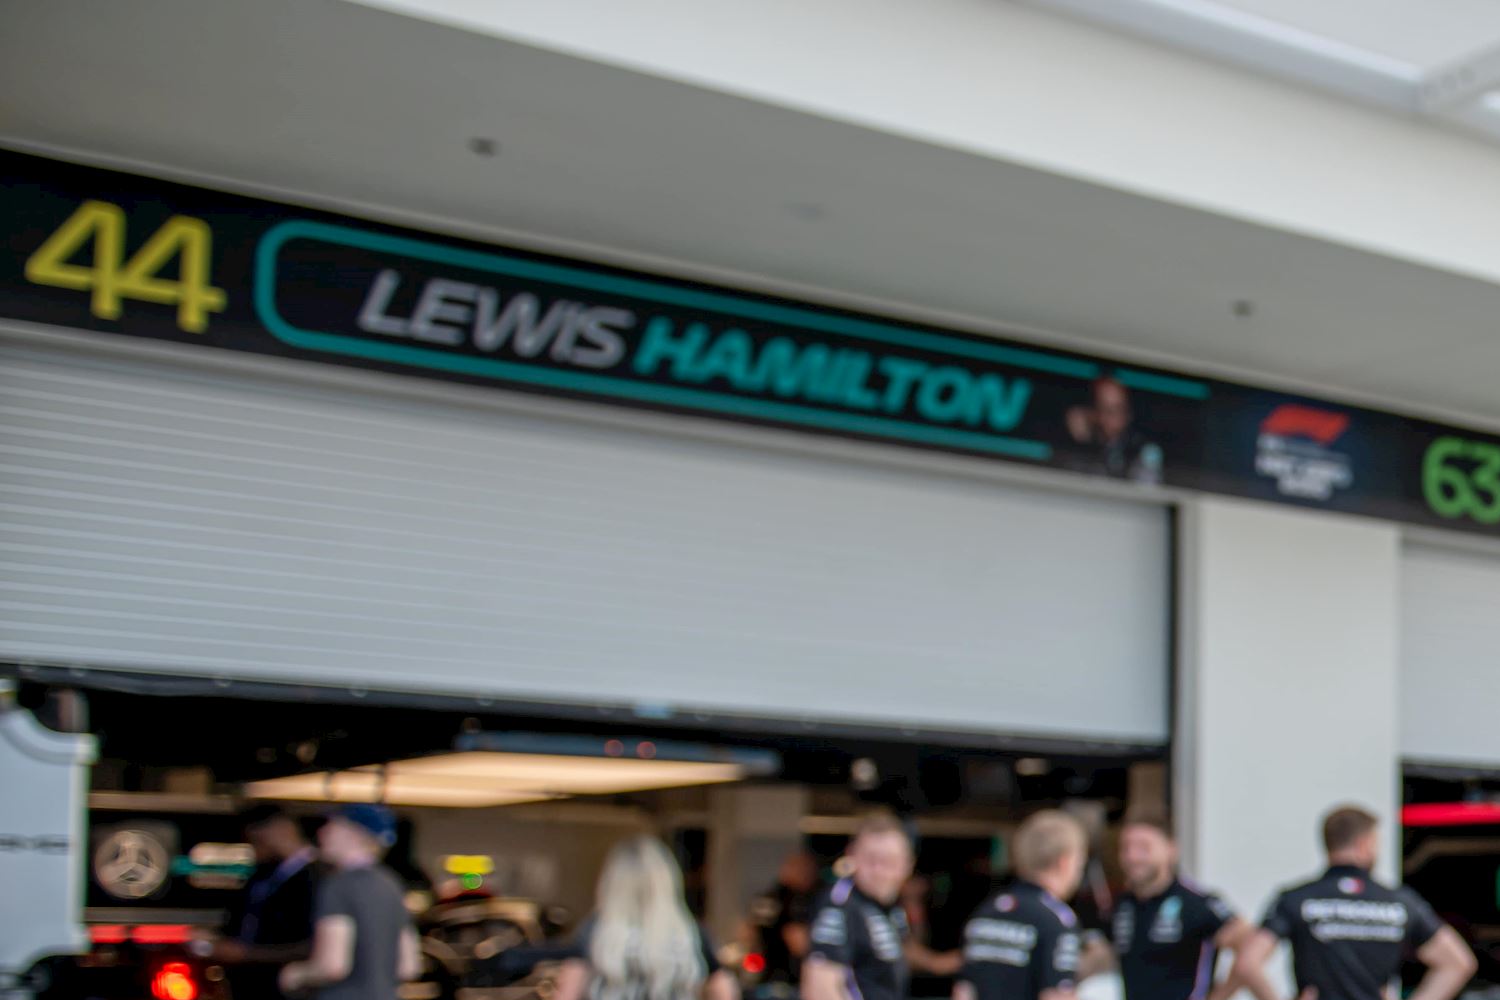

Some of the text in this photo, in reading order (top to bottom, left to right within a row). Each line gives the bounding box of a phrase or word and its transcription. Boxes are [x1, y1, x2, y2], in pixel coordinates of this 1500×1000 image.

[24, 200, 1033, 431] 44 LEWIS HAMILTON
